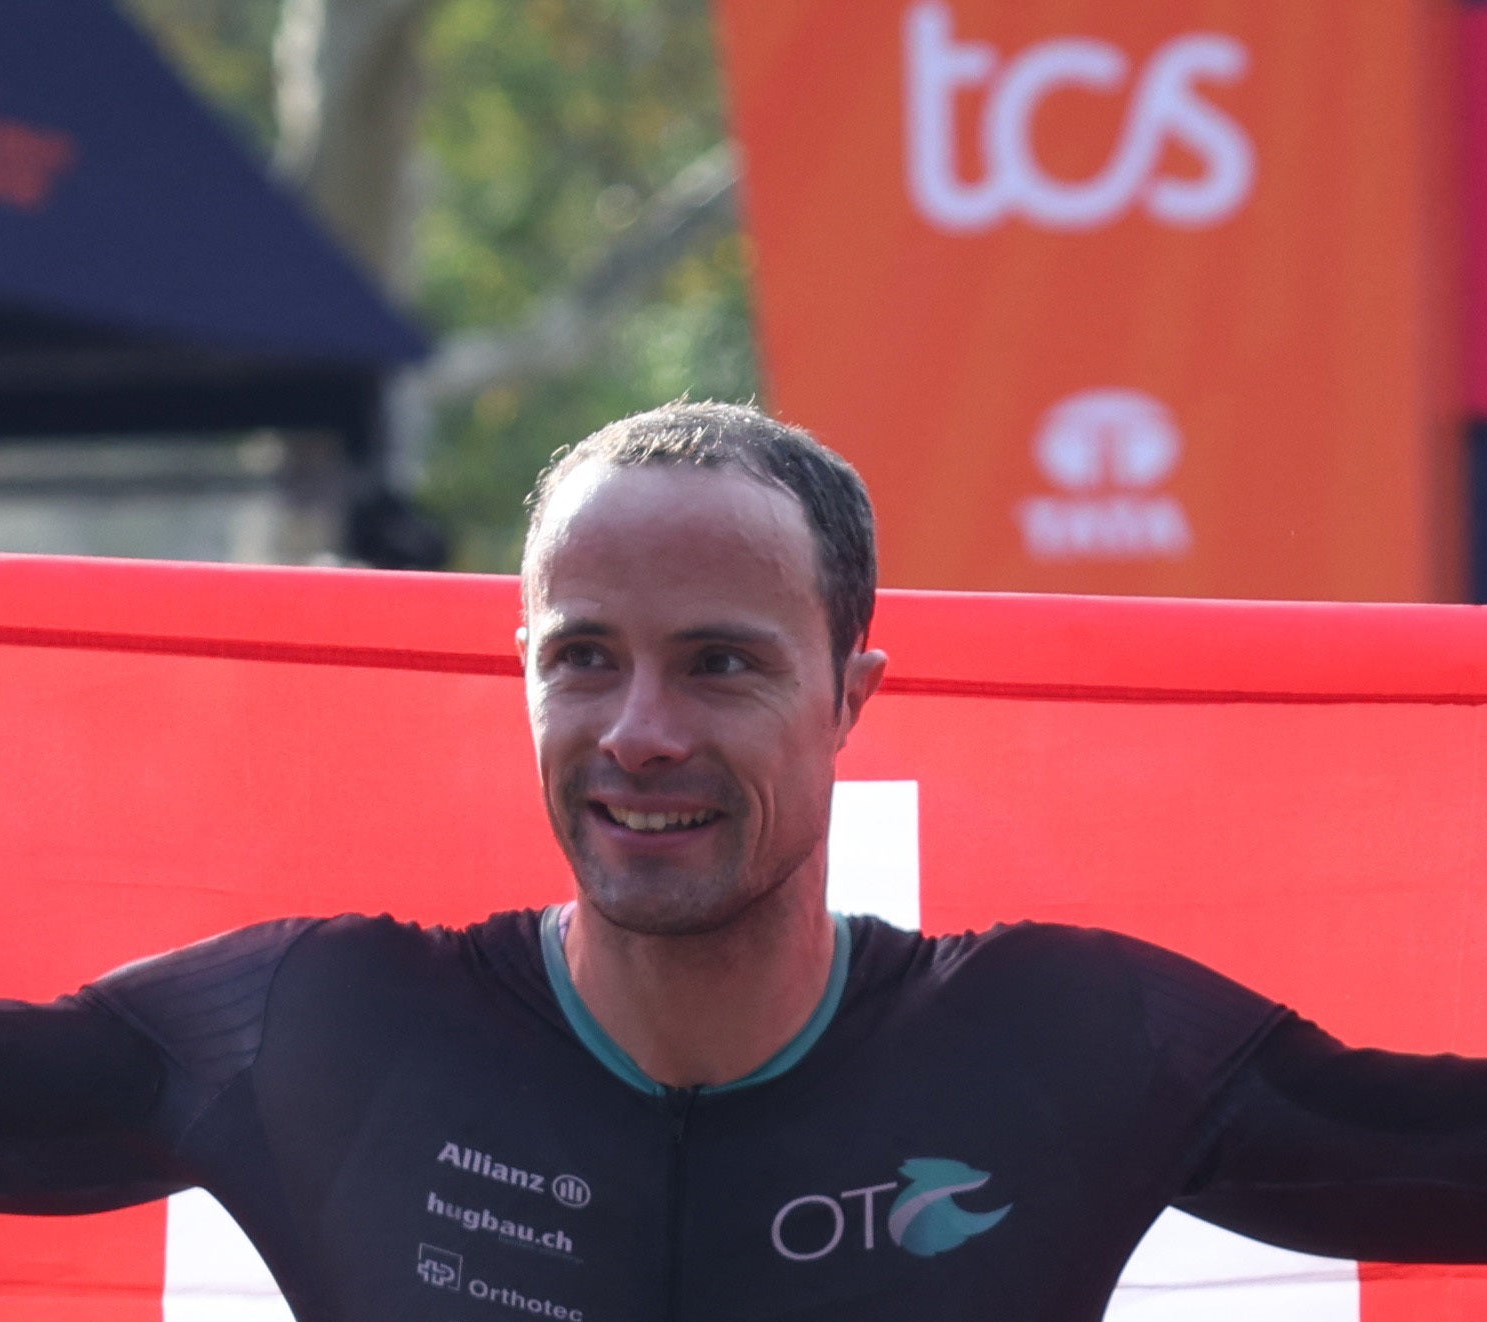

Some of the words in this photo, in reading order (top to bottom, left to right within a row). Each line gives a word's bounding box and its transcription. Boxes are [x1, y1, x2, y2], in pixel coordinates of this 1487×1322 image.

[903, 0, 1255, 233] tcs
[437, 1142, 545, 1192] Allianz
[427, 1192, 573, 1253] hugbau.ch
[468, 1279, 584, 1322] Orthotec
